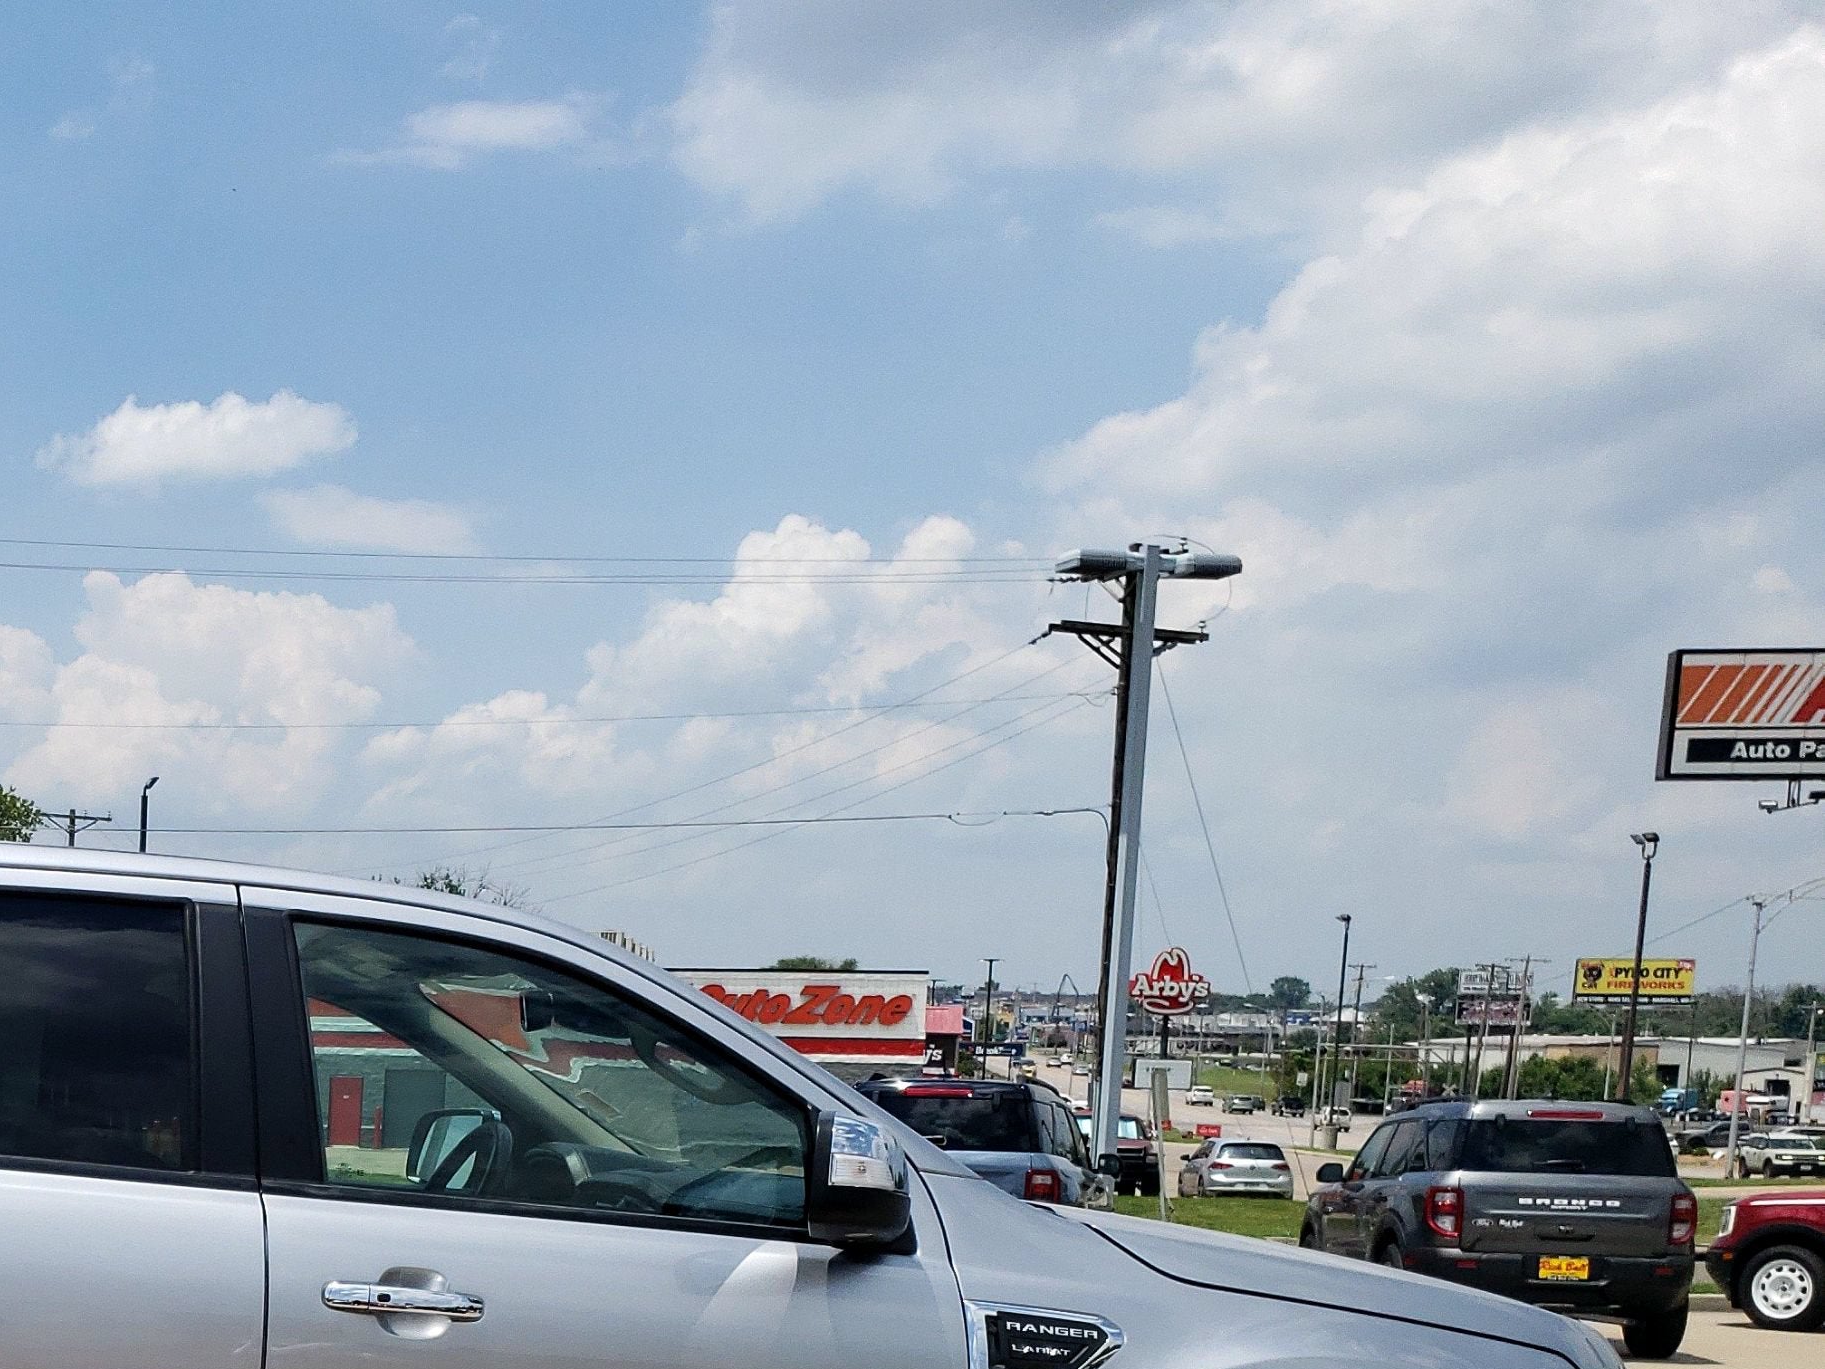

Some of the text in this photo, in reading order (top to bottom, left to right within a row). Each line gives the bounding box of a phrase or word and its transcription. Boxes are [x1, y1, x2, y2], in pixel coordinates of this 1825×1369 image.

[1730, 740, 1791, 759] Auto
[1652, 967, 1681, 979] CITY
[1131, 974, 1210, 1003] Arby's
[1518, 1197, 1621, 1208] BRONCO
[1005, 1320, 1099, 1340] RANGER
